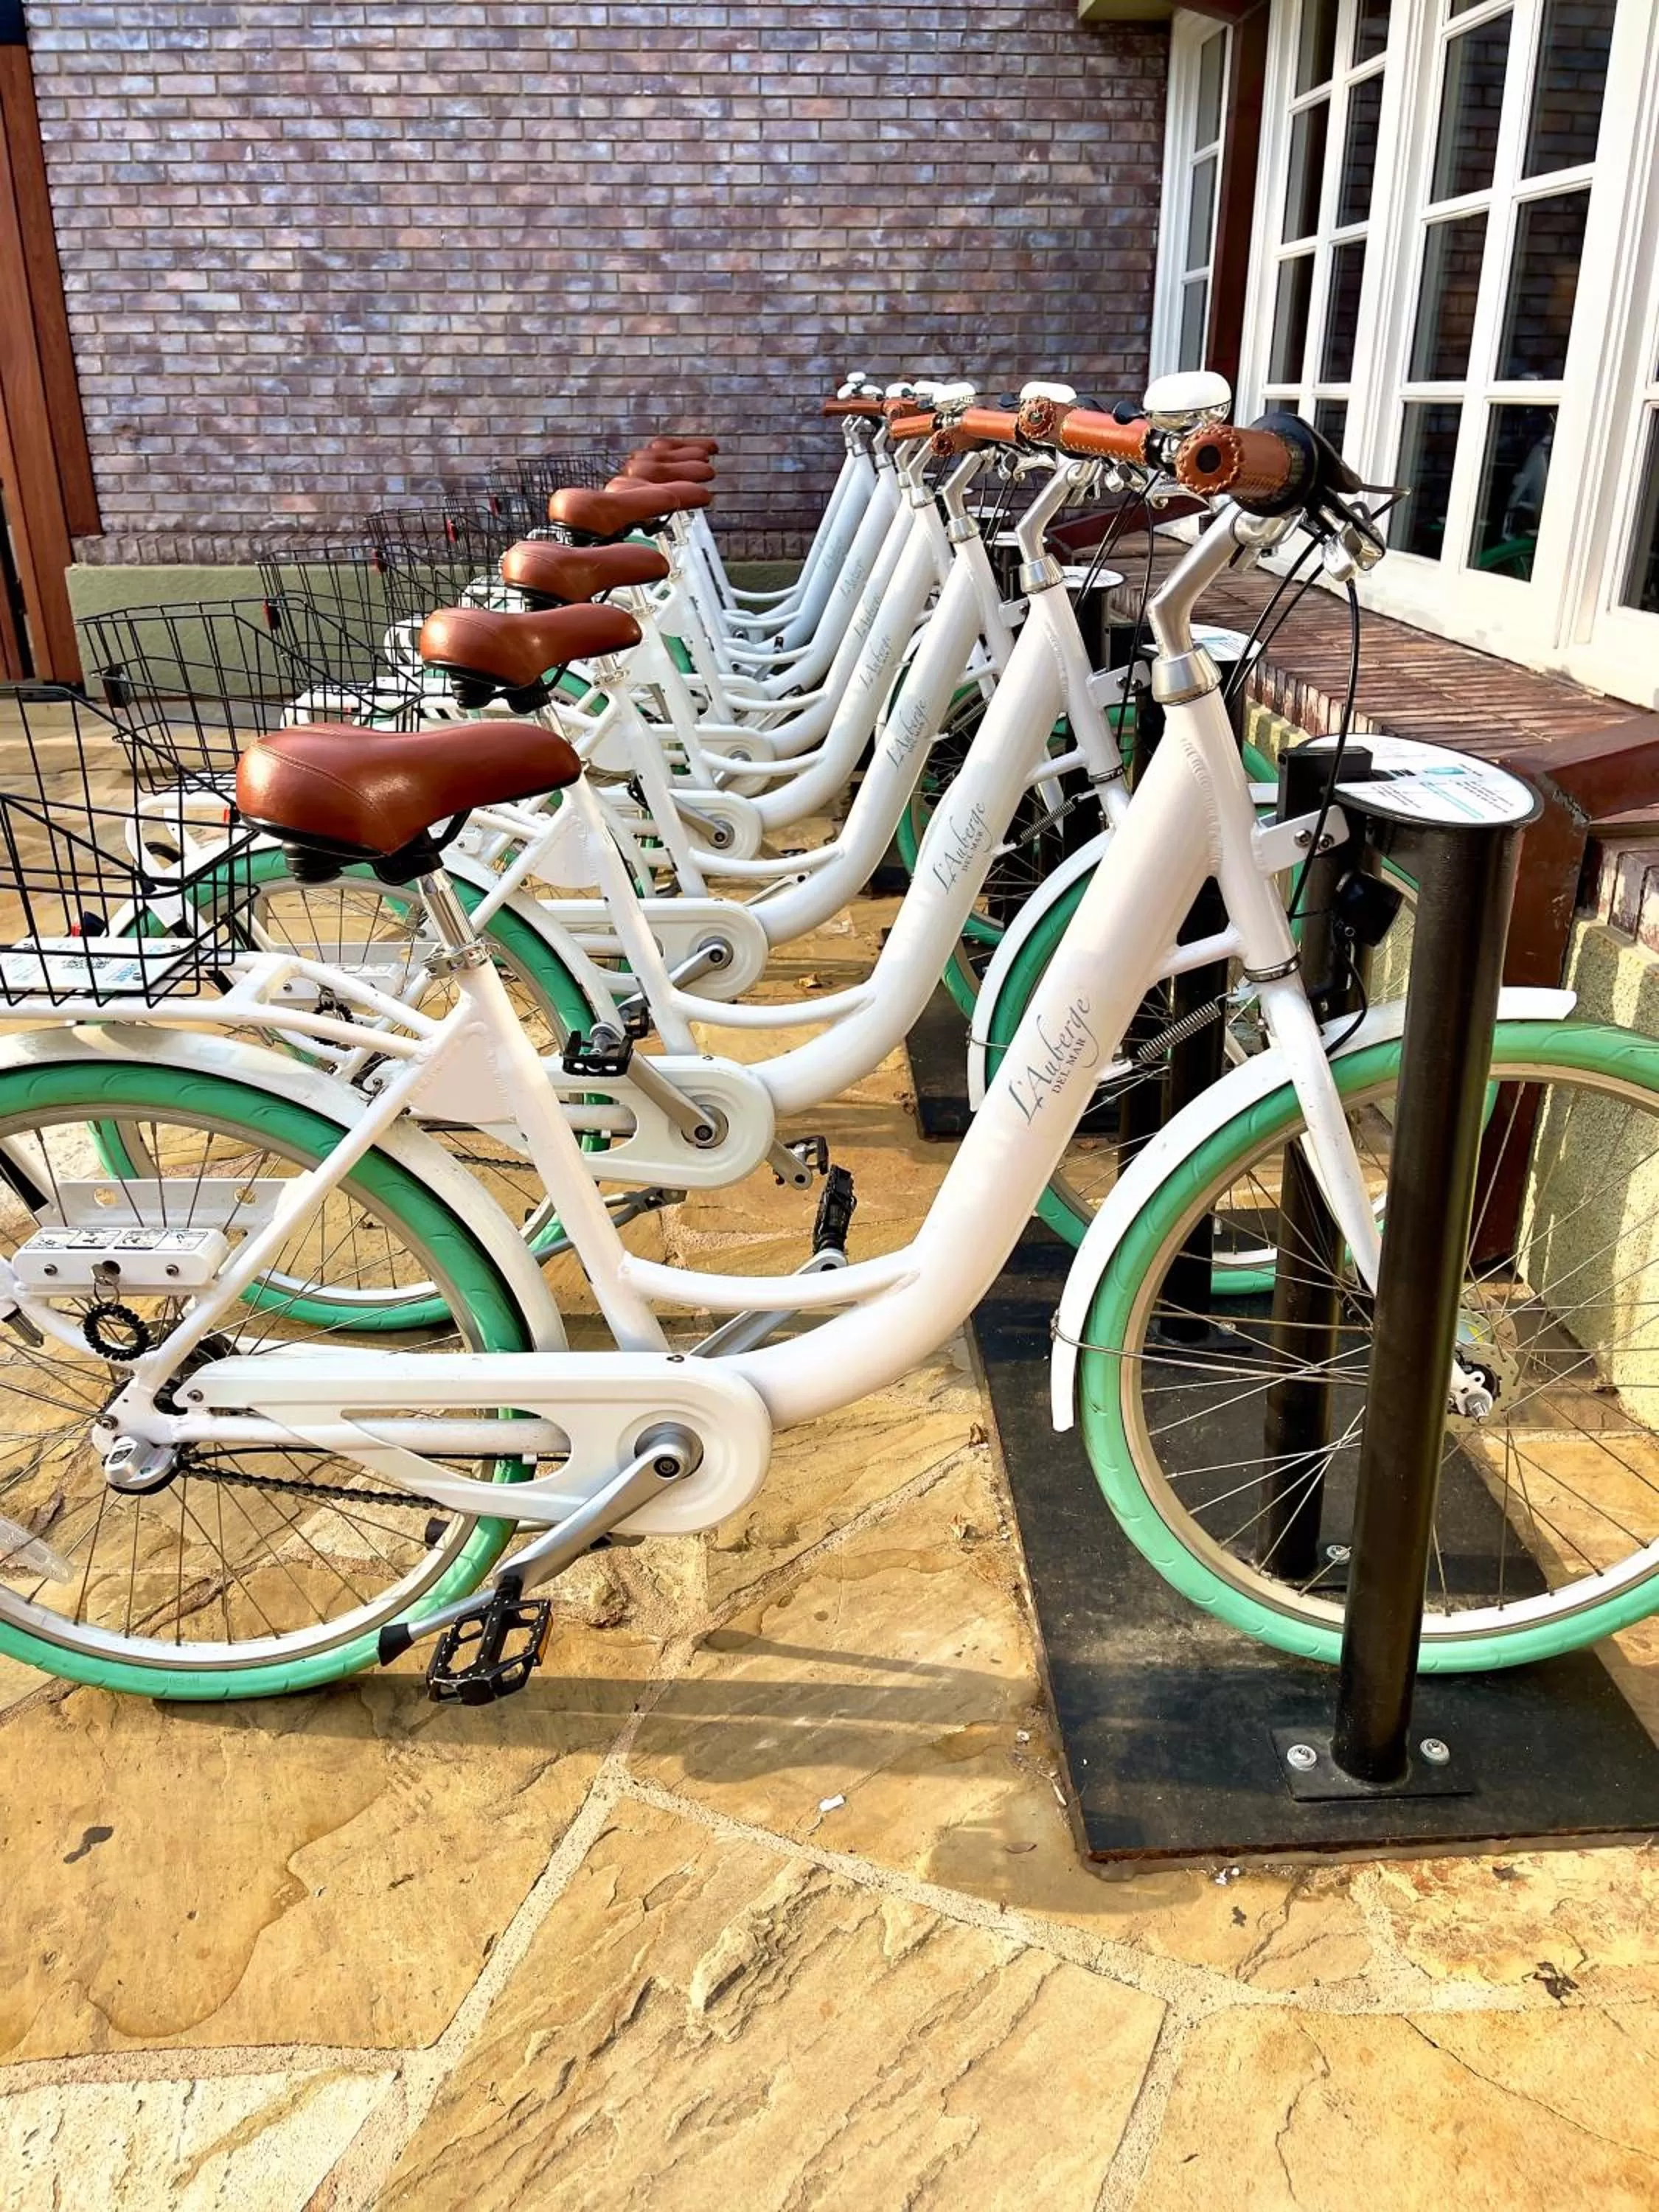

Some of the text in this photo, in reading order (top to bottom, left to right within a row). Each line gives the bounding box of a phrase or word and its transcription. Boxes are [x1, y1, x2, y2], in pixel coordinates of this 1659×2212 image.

[933, 802, 992, 894] L'Auberge
[1008, 997, 1099, 1125] L'Auberge
[1051, 1038, 1087, 1093] DEL MAR
